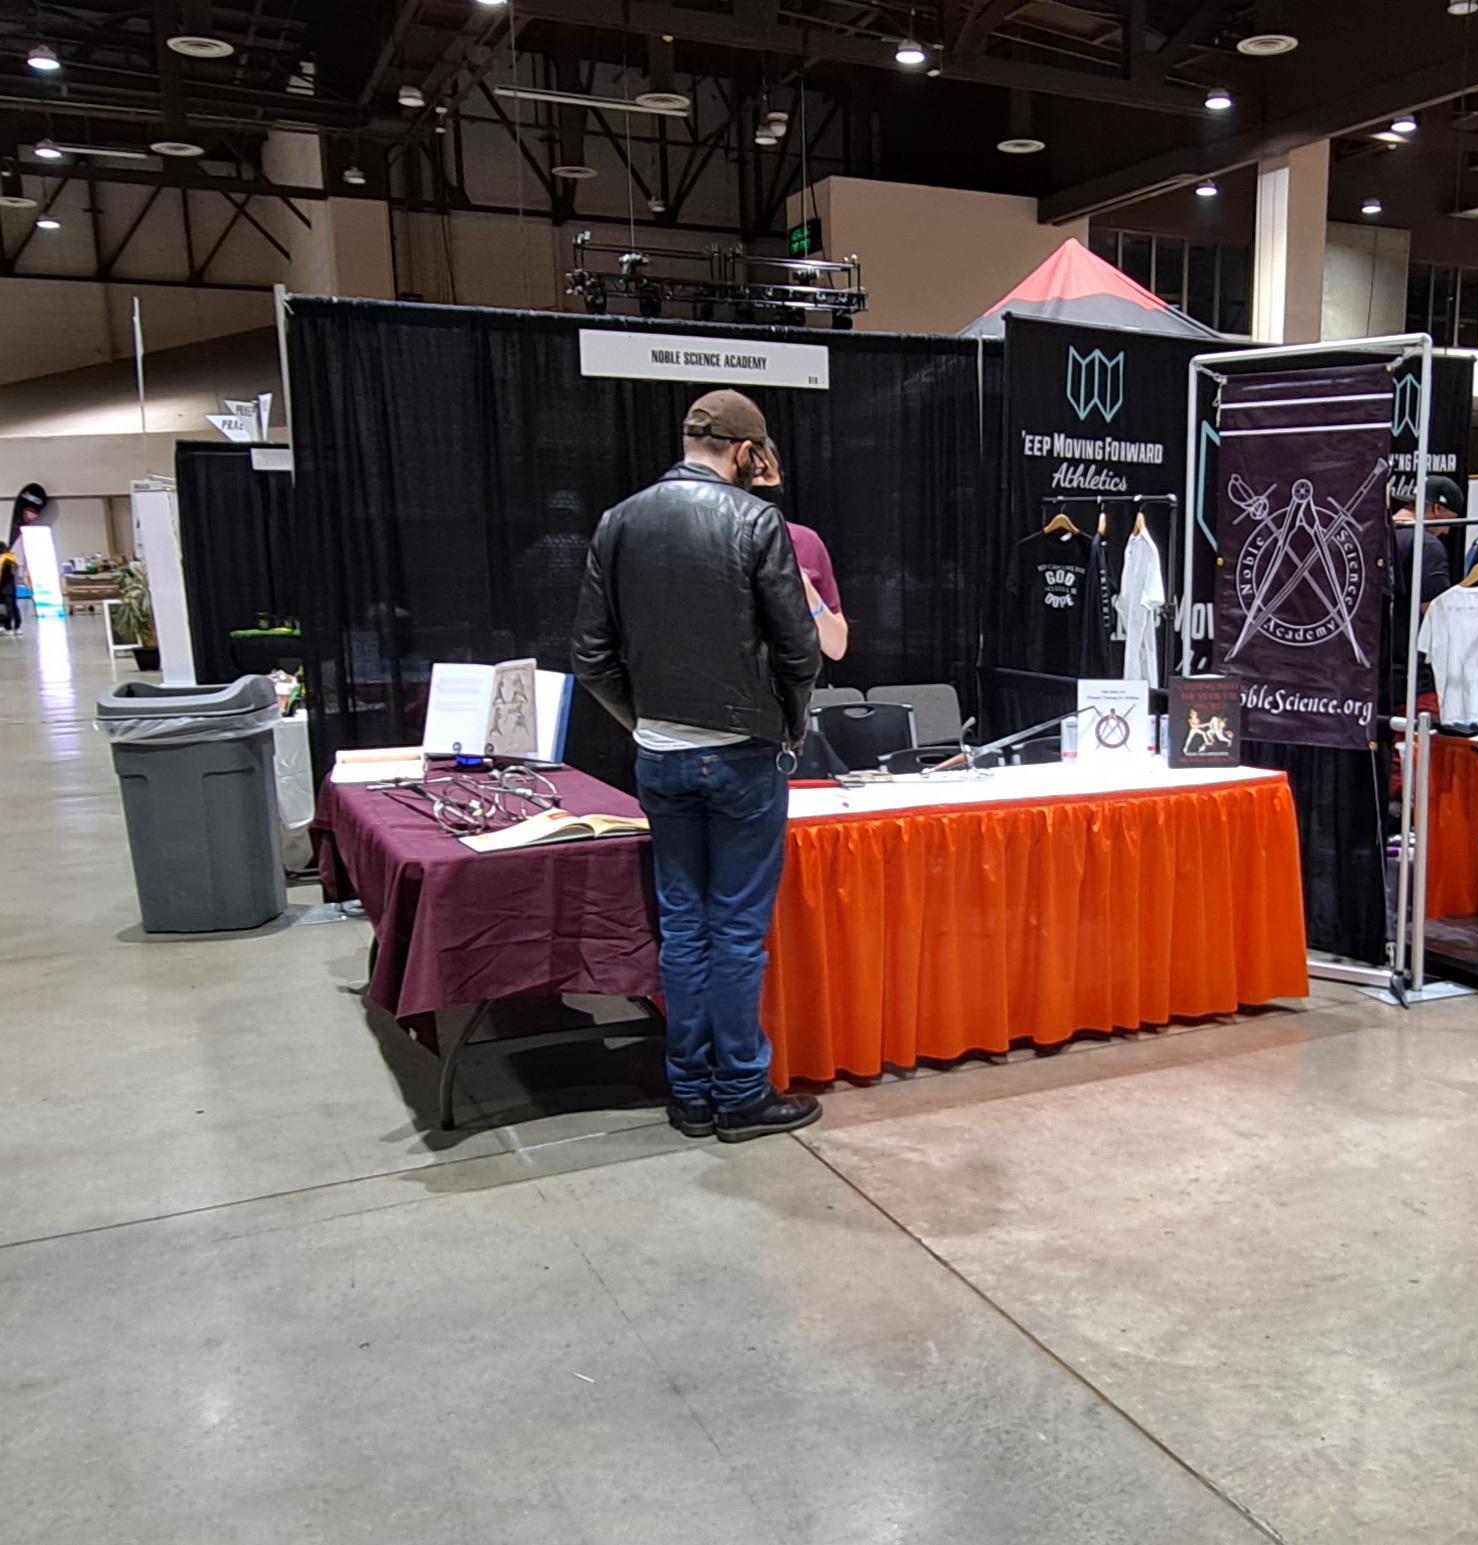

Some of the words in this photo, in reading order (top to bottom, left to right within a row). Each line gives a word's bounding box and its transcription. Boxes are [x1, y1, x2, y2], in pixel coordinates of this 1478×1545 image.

[651, 349, 680, 365] NOBLE
[683, 351, 721, 368] SCIENCE
[723, 354, 767, 370] ACADEMY
[1022, 430, 1051, 456] EEP
[1053, 432, 1103, 460] MOVING
[1052, 462, 1127, 491] Athletics
[1240, 535, 1265, 596] Noble
[1336, 528, 1360, 606] Science
[1263, 616, 1338, 642] Academy
[1240, 684, 1373, 725] obleScience.org
